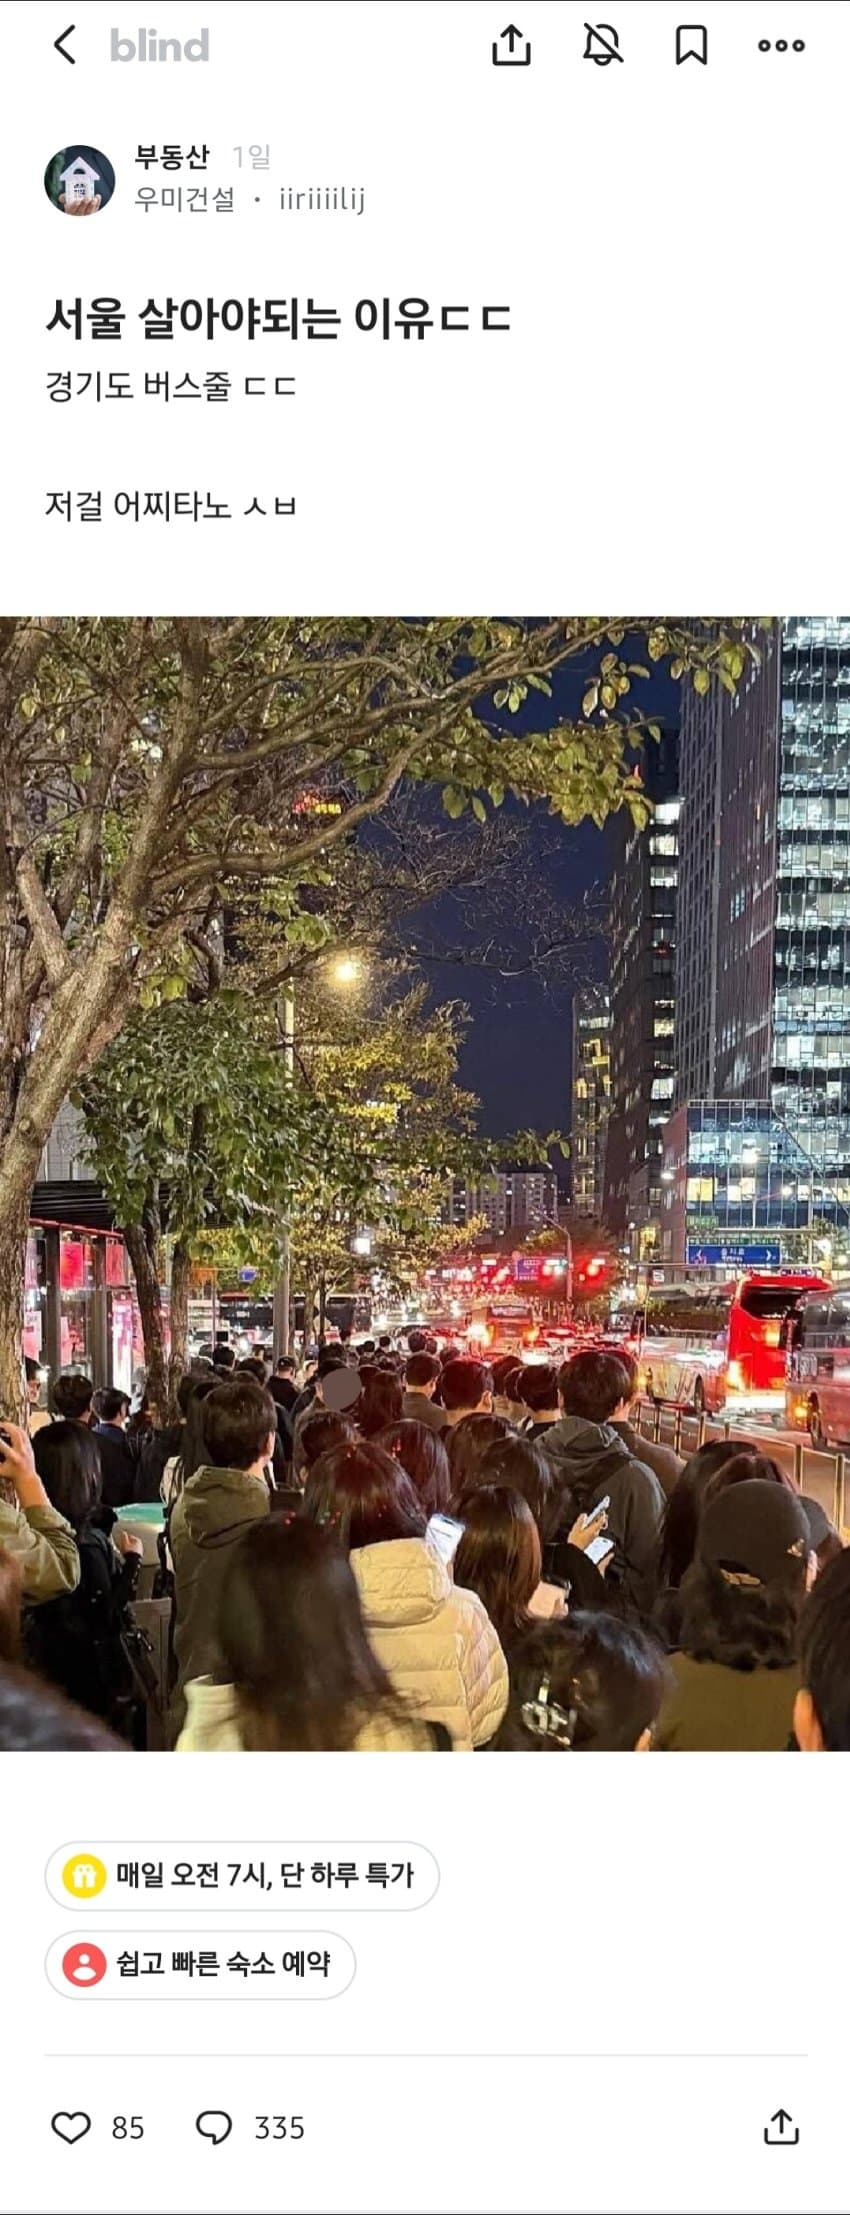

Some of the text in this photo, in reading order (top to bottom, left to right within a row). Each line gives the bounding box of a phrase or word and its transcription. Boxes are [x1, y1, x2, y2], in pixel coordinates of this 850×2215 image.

[110, 28, 209, 62] blind
[134, 143, 270, 171] 부동산 1일
[134, 186, 235, 213] 우미건설
[45, 296, 511, 341] 서울 살아야되는 이유ㄷㄷ
[45, 370, 297, 404] 경기도 버스줄 ㄷㄷ
[44, 489, 296, 523] 저걸 어찌타노 ㅅㅂ
[116, 1861, 415, 1892] 매일 오전 7시, 단 하루 특가
[116, 1949, 331, 1978] 쉽고 빠른 숙소 예약
[111, 2115, 305, 2140] 85 335
